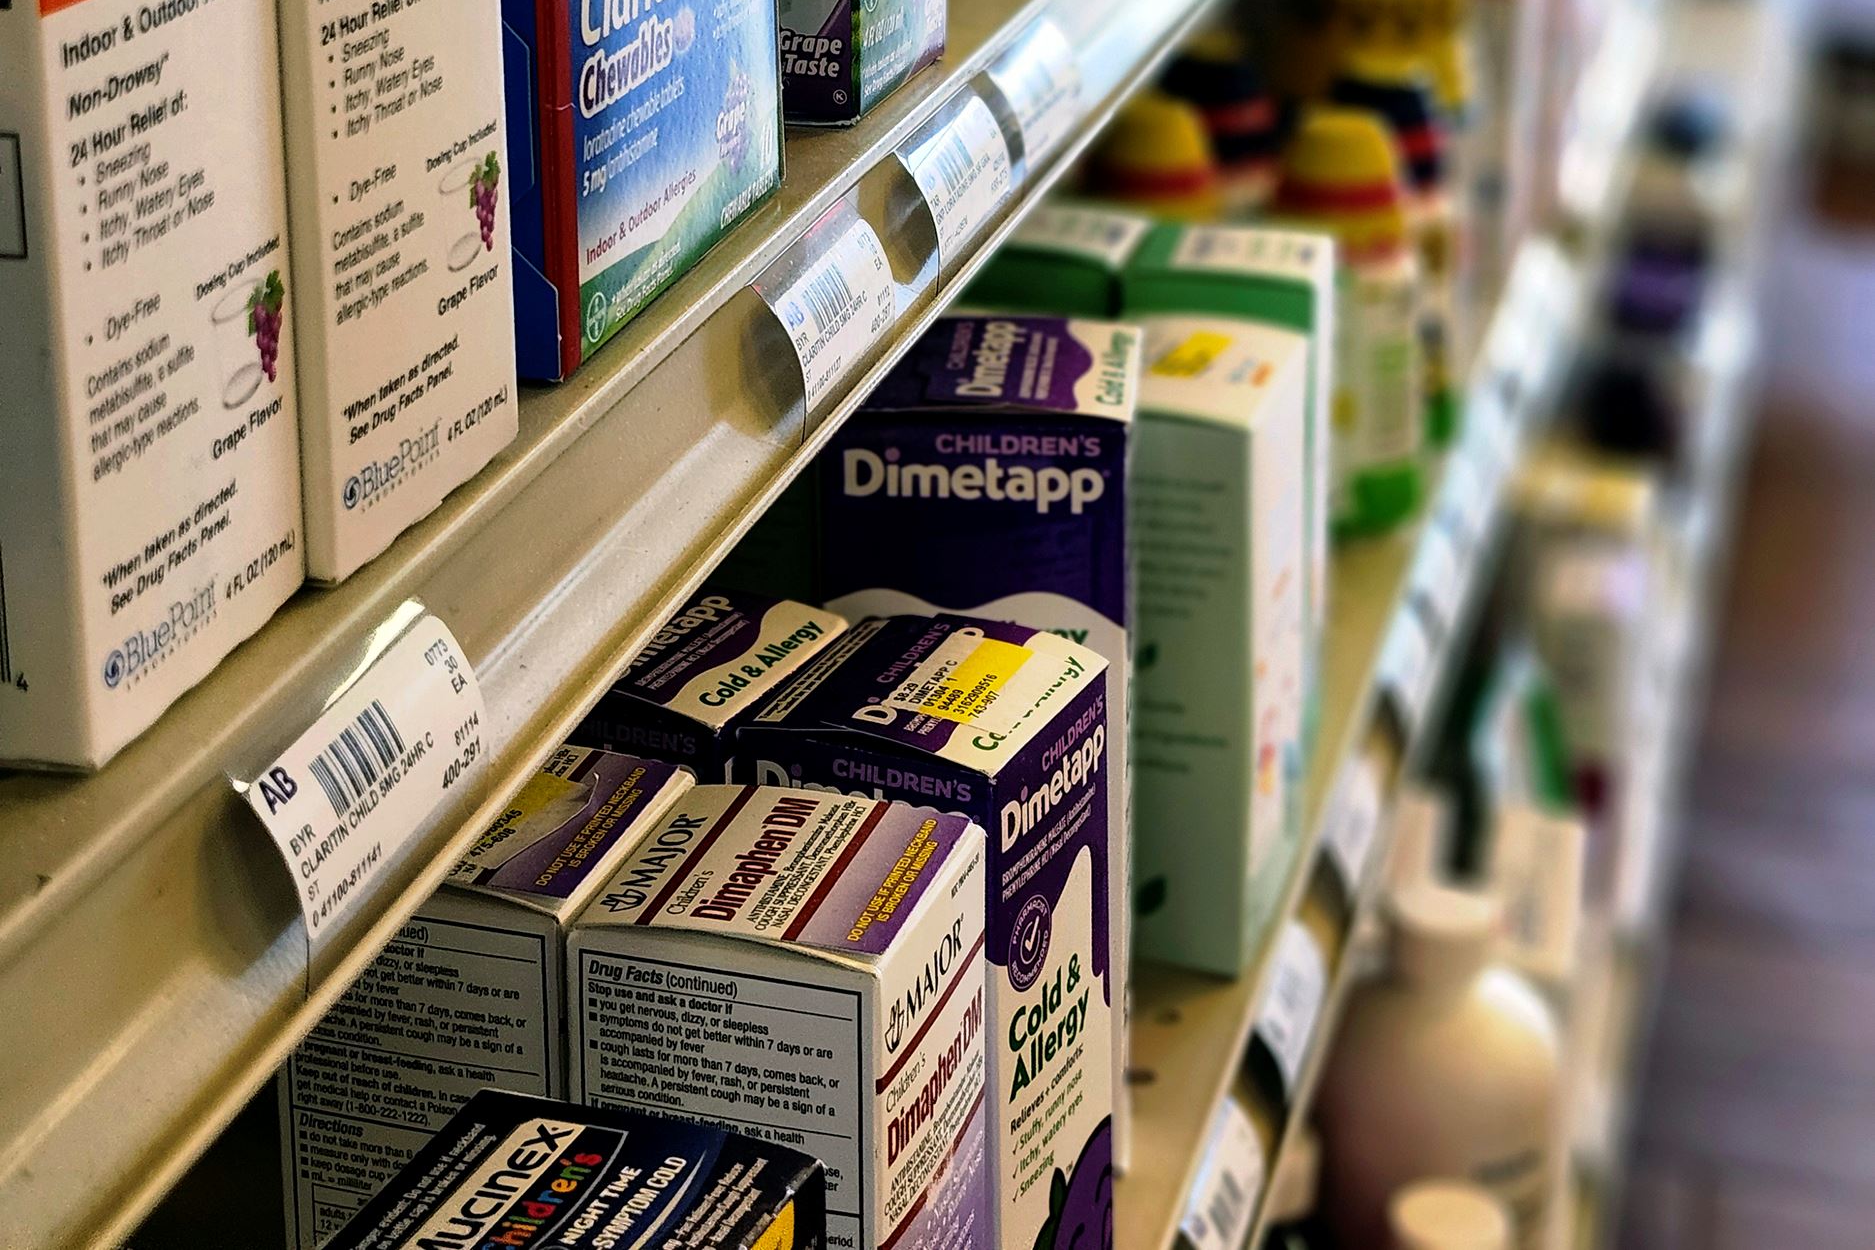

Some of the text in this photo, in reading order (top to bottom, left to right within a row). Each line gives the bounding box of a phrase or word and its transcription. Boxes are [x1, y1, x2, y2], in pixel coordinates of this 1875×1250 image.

[62, 27, 117, 67] Indoor
[121, 15, 134, 41] &
[321, 21, 336, 46] 24
[338, 11, 368, 37] Hour
[781, 31, 843, 58] Grape
[580, 16, 673, 116] Chewables
[784, 54, 840, 78] Taste
[585, 168, 696, 265] Indoor & Outdoor Allergies
[437, 264, 498, 316] Grape Flavor
[378, 373, 405, 401] taken
[407, 364, 419, 382] as
[420, 335, 458, 372] directed.
[212, 395, 283, 459] Grape Flavor
[349, 361, 451, 444] See Drug Facts Panel.
[935, 434, 1102, 456] CHILDREN'S
[843, 448, 1105, 514] Dimetapp
[444, 655, 458, 674] 30
[451, 673, 468, 694] EA
[699, 673, 751, 707] Cold
[741, 665, 765, 679] &
[755, 620, 825, 668] Allergy
[877, 622, 950, 684] CHILDREN'S
[908, 666, 948, 704] DIMETAPP
[922, 685, 949, 707] 01304
[936, 688, 964, 711] 94489
[962, 690, 999, 718] 743-907
[454, 711, 479, 746] 81114
[1042, 694, 1107, 771] CHILDREN'S
[259, 766, 298, 815] AB
[442, 736, 481, 789] 400-291
[833, 758, 972, 803] CHILDREN'S
[1000, 724, 1105, 854] Dimetapp
[301, 731, 434, 881] CLARITIN CHILD 5MG 24HR C
[289, 824, 316, 857] BYR
[620, 813, 707, 887] MAJOR
[691, 825, 795, 920] Dimaphen
[762, 796, 819, 827] DM
[308, 882, 321, 902] ST
[665, 870, 713, 914] Children's
[861, 915, 874, 930] NOT
[871, 896, 886, 916] USE
[887, 857, 911, 888] PRINTED
[903, 818, 936, 857] NECKBAND
[884, 881, 910, 913] BROKEN
[902, 869, 918, 882] OR
[910, 838, 937, 870] MISSING
[588, 959, 737, 999] Drug Facts (continued)
[906, 914, 963, 1026] MAJOR
[598, 999, 769, 1035] you get nervous, dizzy, or sleepless
[1008, 952, 1080, 1051] Cold &
[887, 985, 982, 1166] Dimaphen DM
[1009, 988, 1088, 1102] Allergy
[885, 1051, 925, 1113] Children's
[1010, 1091, 1044, 1135] Relieves
[1050, 1043, 1083, 1089] comforts:
[1019, 1068, 1082, 1149] Stuffy, runny nose
[1019, 1090, 1083, 1173] Itchy, watery eyes
[648, 1156, 686, 1194] COLD
[1019, 1149, 1054, 1197] Sneezing
[563, 1196, 610, 1242] NIGHT
[608, 1167, 641, 1207] TIME
